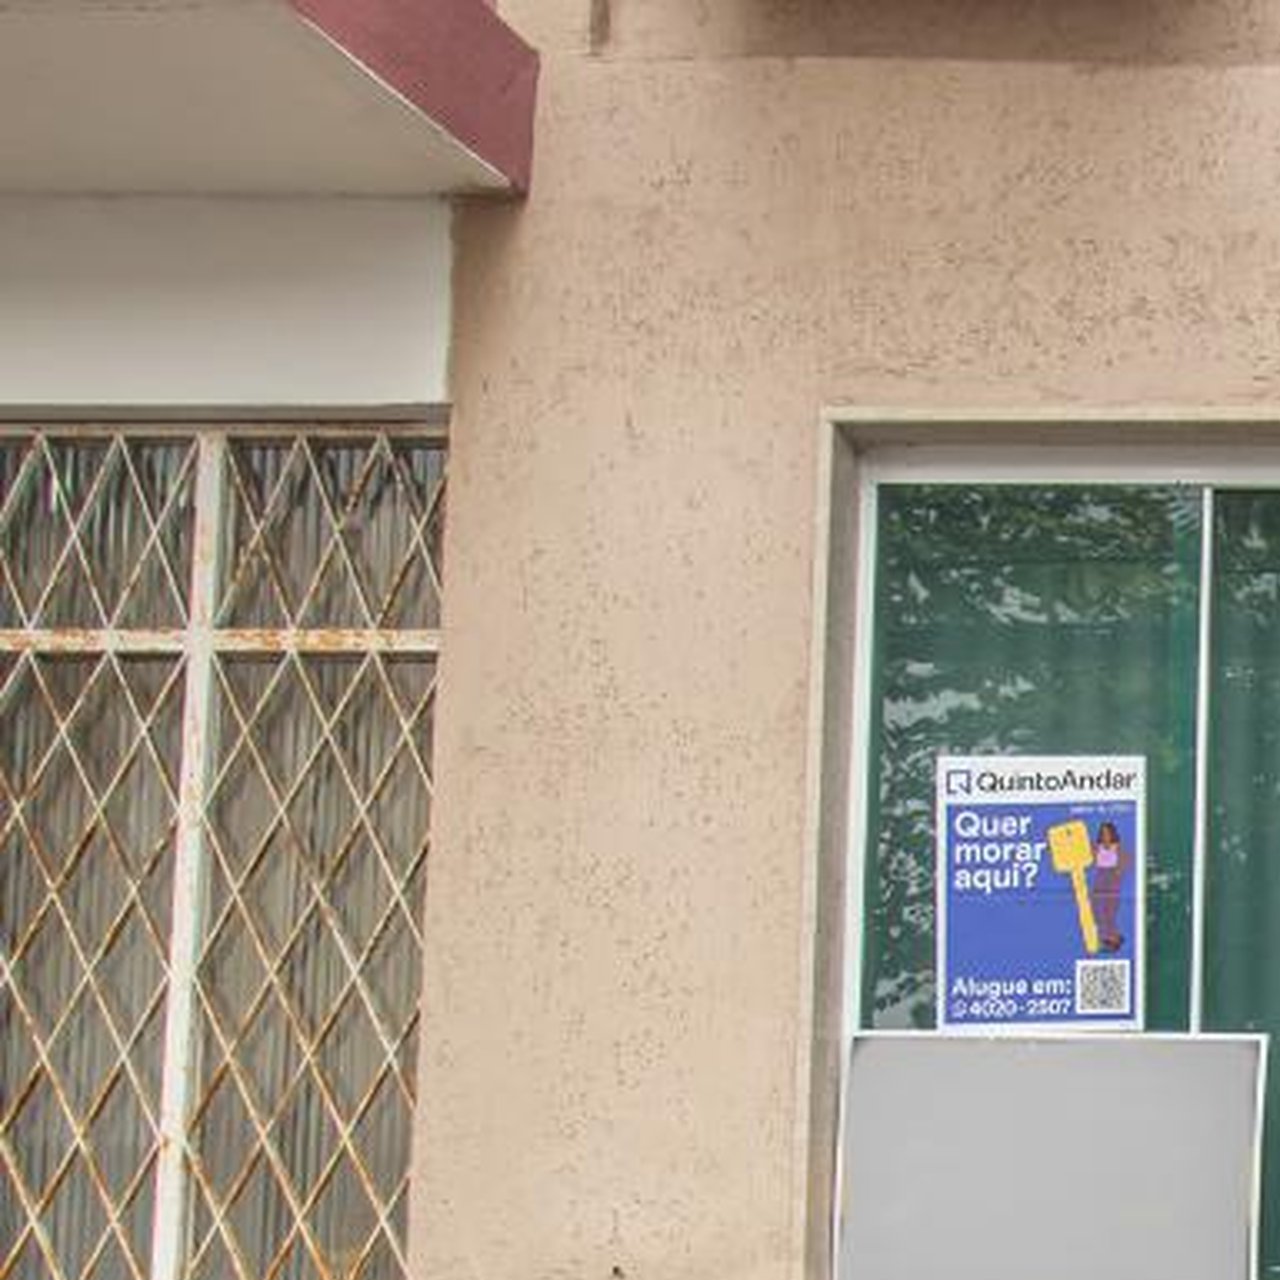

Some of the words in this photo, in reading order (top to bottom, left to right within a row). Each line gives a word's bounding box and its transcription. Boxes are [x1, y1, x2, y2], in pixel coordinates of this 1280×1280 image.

[976, 769, 1136, 792] QuintoAndar
[954, 811, 1031, 837] Quer
[954, 841, 1046, 863] morar
[954, 863, 1038, 894] aqui?
[952, 977, 1028, 998] Alugue
[1032, 978, 1072, 995] em:
